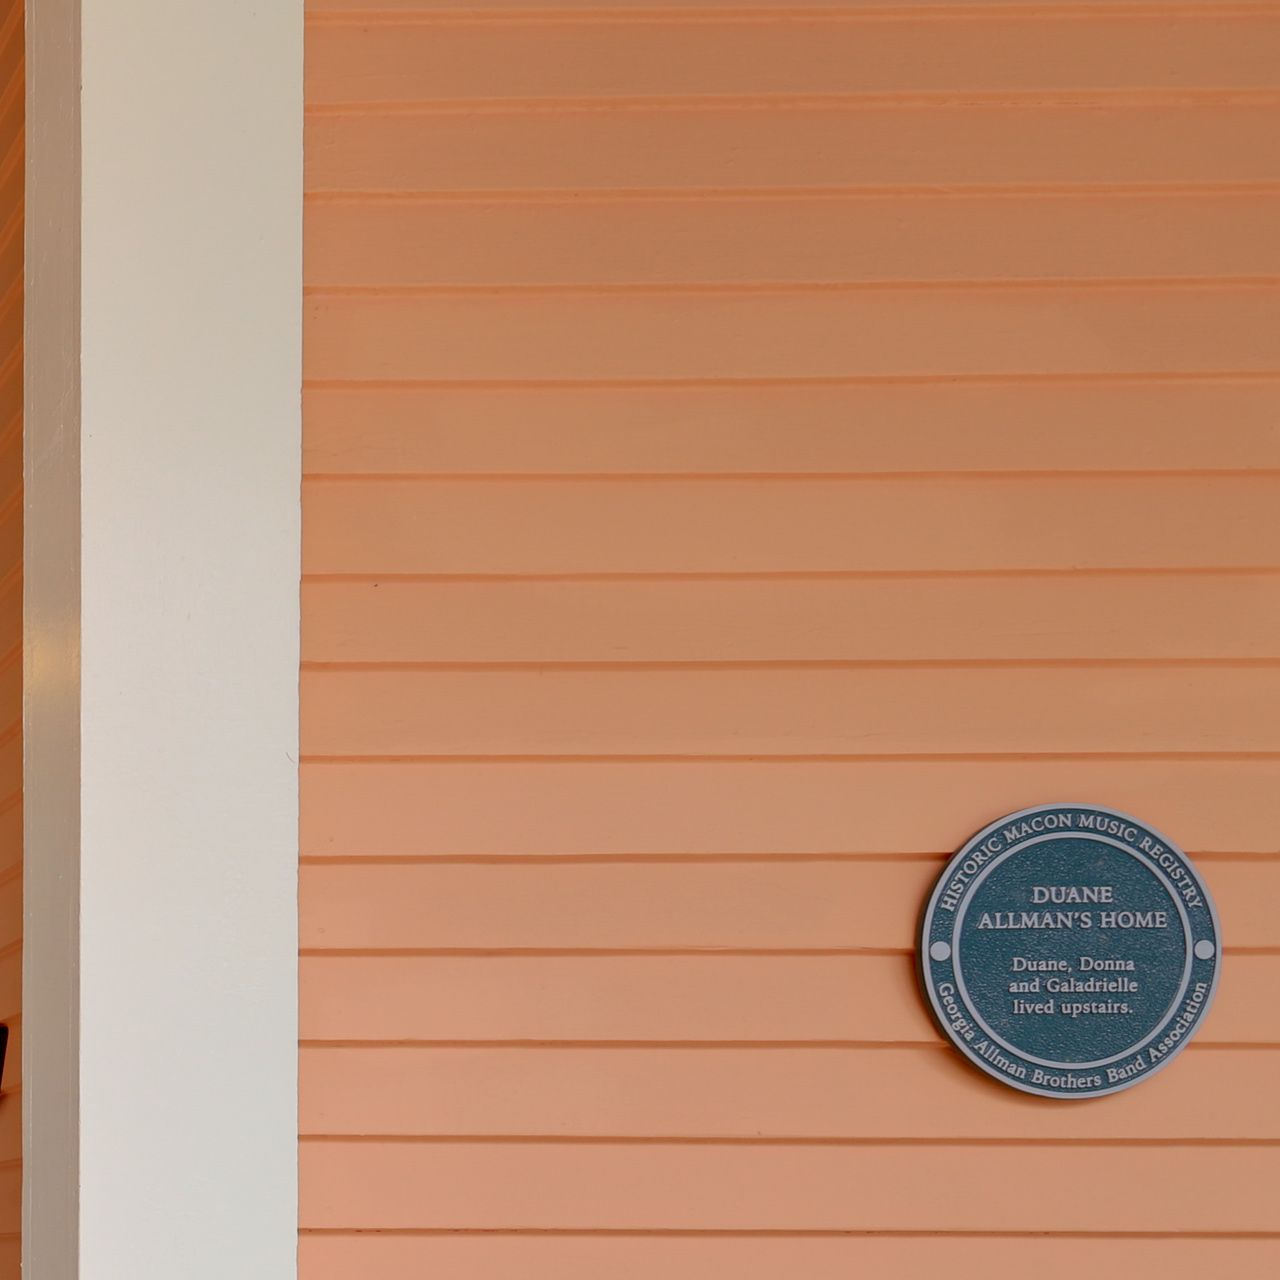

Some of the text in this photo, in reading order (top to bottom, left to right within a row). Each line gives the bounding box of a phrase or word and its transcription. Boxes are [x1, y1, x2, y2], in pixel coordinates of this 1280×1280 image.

[941, 814, 1203, 912] HISTORIC MACON MUSIC REGISTRY
[1031, 886, 1113, 904] DUANE
[977, 912, 1168, 929] ALLMAN'S HOME
[1013, 957, 1135, 974] Duane, Donna
[1009, 978, 1138, 993] and Galadrielle
[1013, 1000, 1133, 1018] lived upstairs.
[938, 982, 1207, 1088] Georgia Allman Brothers Band Association
